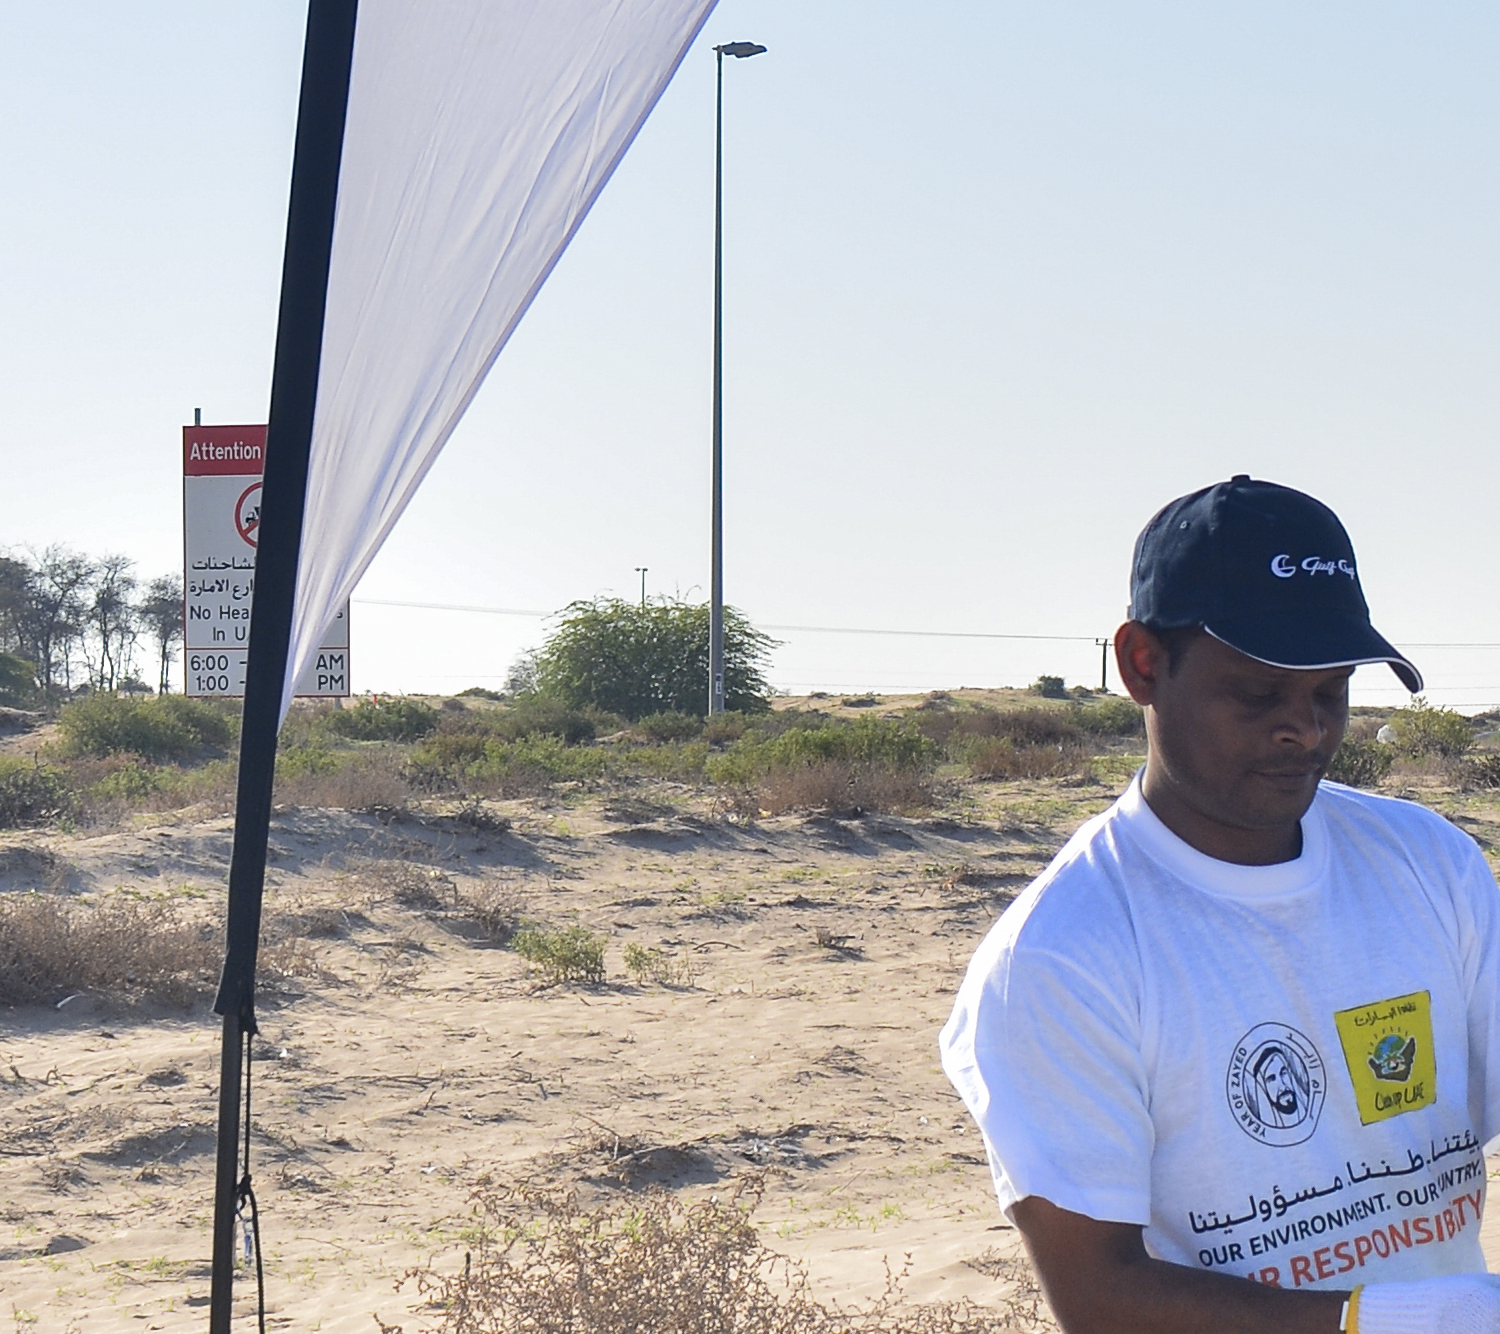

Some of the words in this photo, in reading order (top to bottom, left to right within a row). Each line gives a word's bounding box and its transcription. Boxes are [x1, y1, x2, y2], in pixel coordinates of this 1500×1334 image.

[189, 441, 262, 461] Attention
[190, 605, 211, 620] No
[219, 605, 250, 620] Hea
[212, 626, 226, 642] In
[190, 654, 229, 672] 6:00
[315, 653, 345, 671] AM
[195, 674, 229, 692] 1:00
[318, 674, 345, 691] PM
[1230, 1046, 1247, 1088] ZAYED
[1232, 1093, 1244, 1109] OF
[1240, 1112, 1266, 1138] YEAR
[1198, 1241, 1246, 1268] OUR
[1249, 1192, 1391, 1257] ENVIRONMENT.
[1396, 1184, 1440, 1208] OUR
